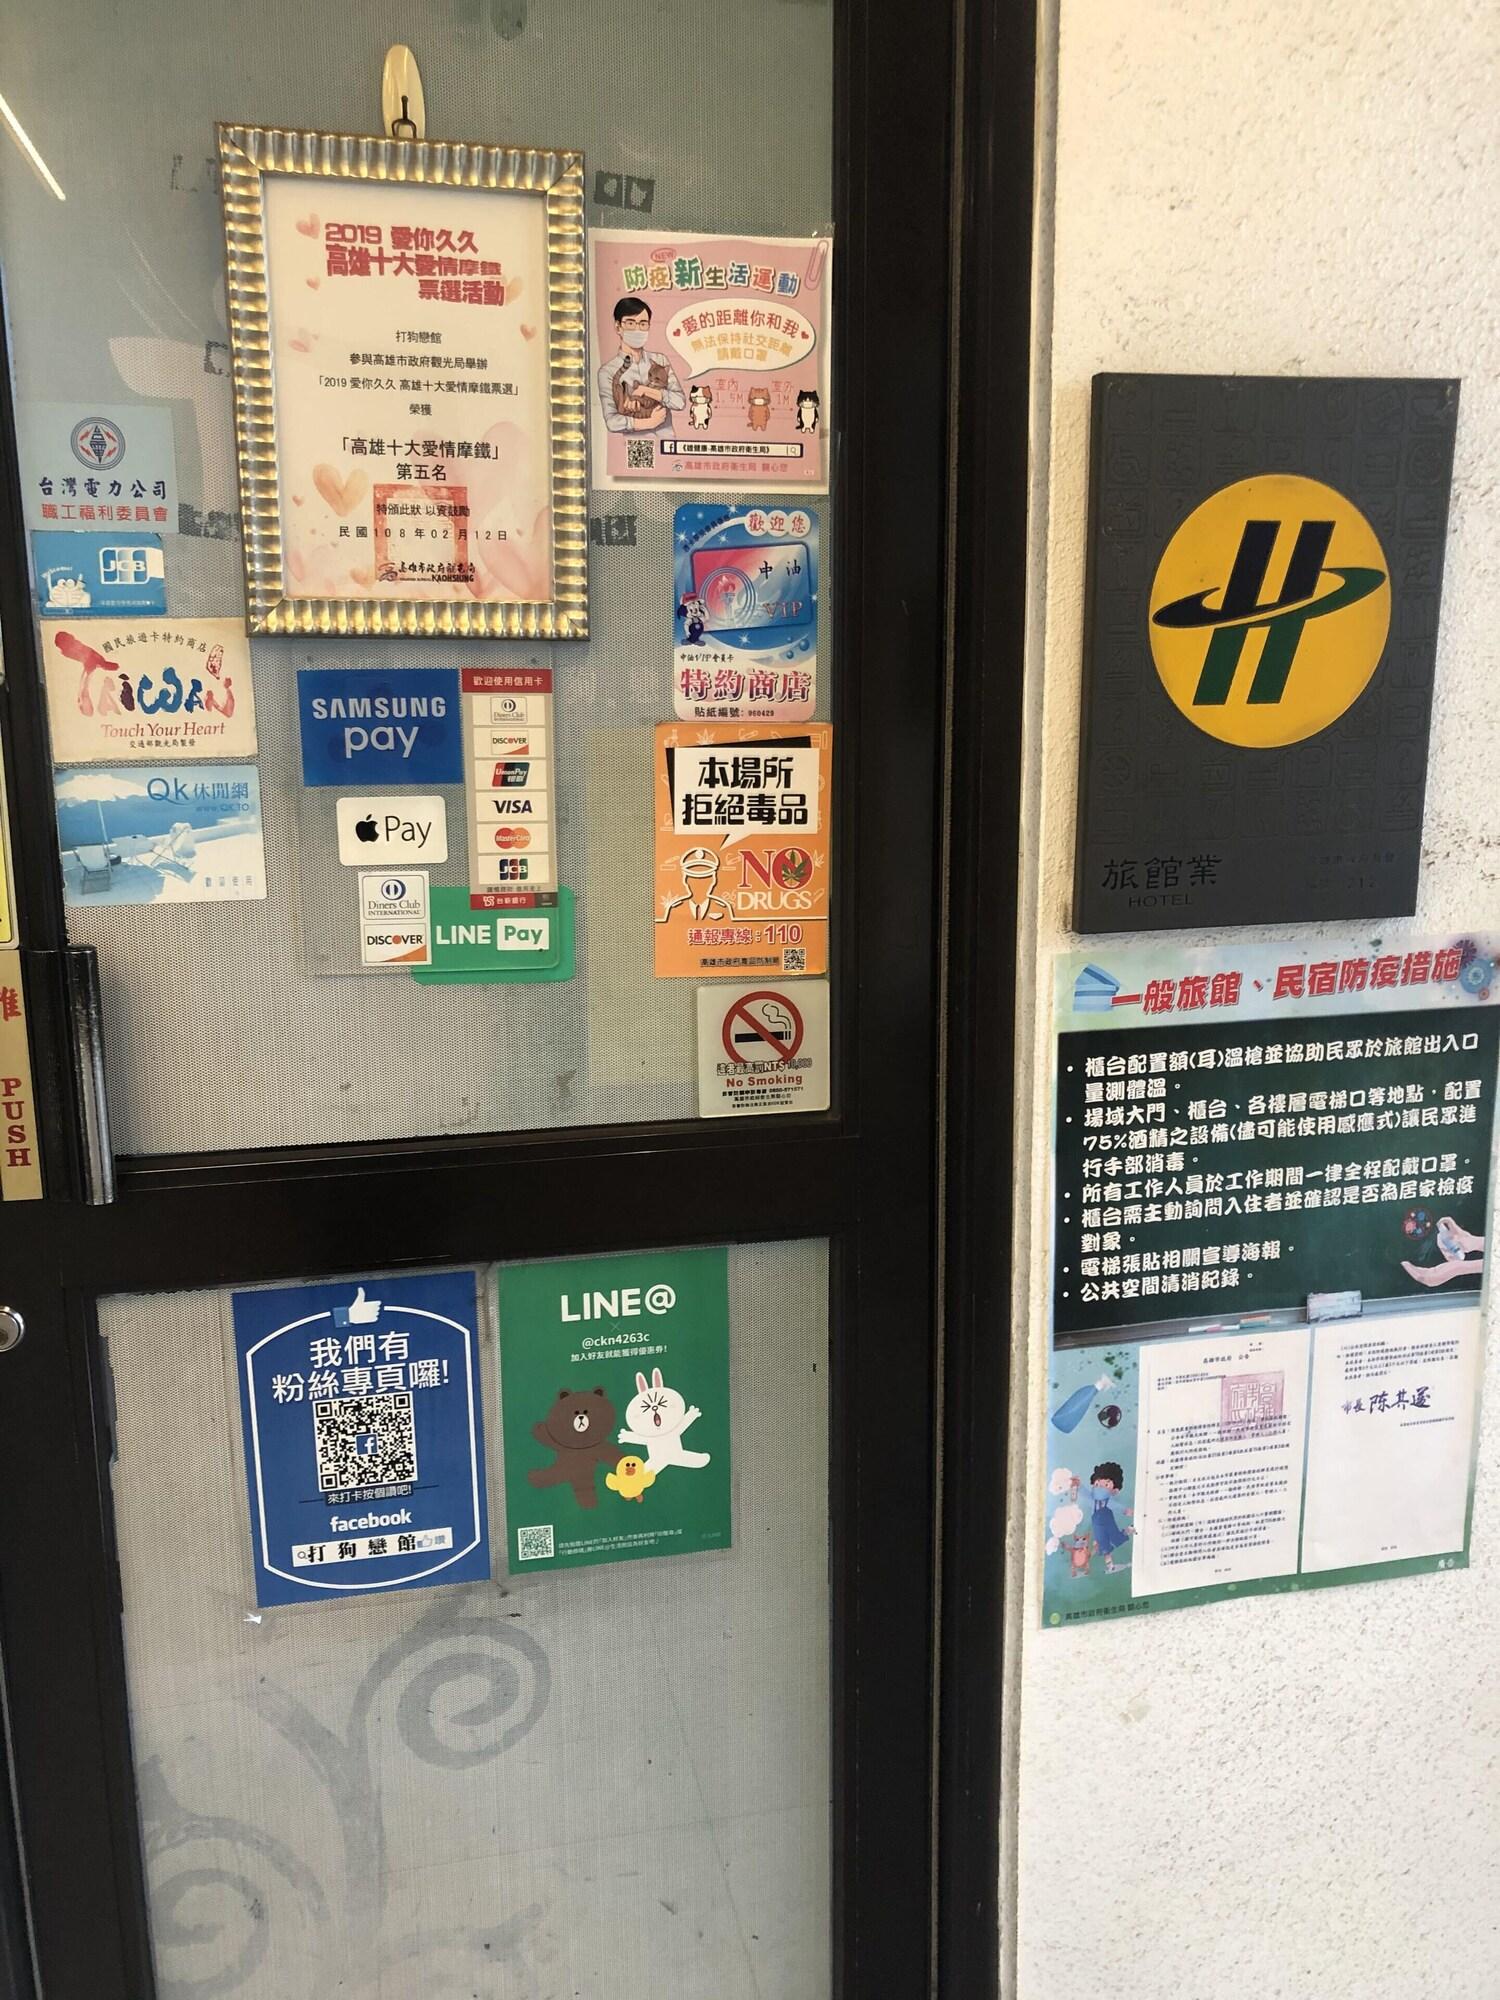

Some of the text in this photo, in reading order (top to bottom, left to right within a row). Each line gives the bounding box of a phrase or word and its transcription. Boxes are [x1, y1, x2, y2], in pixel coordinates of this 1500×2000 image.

[325, 223, 478, 254] 2019 愛你久久
[326, 244, 502, 277] 高雄十大愛情摩鐵
[624, 257, 800, 297] 防疫新生活運動
[418, 279, 505, 306] 票選活動
[682, 309, 799, 338] 愛的距離你和我
[396, 329, 442, 344] 打狗戀館
[350, 353, 488, 370] 參與高雄市政府觀光局舉辦
[350, 377, 396, 391] 愛你久久
[409, 404, 432, 416] 榮獲
[343, 437, 500, 459] 「高雄十大愛情摩鐵」
[396, 463, 447, 481] 第五名
[39, 477, 167, 500] 台灣電力公司
[41, 503, 168, 522] 職工福利委員會
[376, 504, 421, 516] 特頒此狀
[748, 513, 807, 533] 歡迎您
[103, 560, 146, 572] JCB
[759, 560, 802, 579] 中油
[103, 631, 207, 653] 國民旅遊卡特約商店
[473, 676, 543, 686] 歡迎使用信用卡
[680, 668, 811, 702] 特約商店
[312, 697, 446, 720] SAMSUNG
[101, 722, 225, 739] Touch Your Heart
[344, 726, 419, 758] pay
[699, 756, 793, 789] 本場所
[493, 800, 532, 814] VISA
[682, 794, 808, 826] 拒絕毒品
[385, 815, 432, 848] Pay
[500, 865, 528, 874] JCB
[738, 847, 814, 890] NO
[1101, 854, 1223, 891] 旅館業
[368, 900, 421, 909] Diners Club
[737, 891, 812, 911] DRUGS
[1128, 893, 1194, 909] HOTEL
[367, 934, 423, 945] DISCOVER
[436, 925, 542, 945] LINE Pay
[1111, 949, 1462, 1016] 一般旅館、民宿防疫措施
[726, 1075, 803, 1088] No Smoking
[1, 1078, 31, 1167] PUSH
[561, 1284, 677, 1323] LINE@
[310, 1332, 410, 1369] 我們有
[582, 1332, 651, 1349] @ckn4263c
[272, 1360, 449, 1403] 粉絲專頁囉!
[330, 1508, 412, 1532] facebook
[307, 1534, 416, 1563] 打狗戀館
